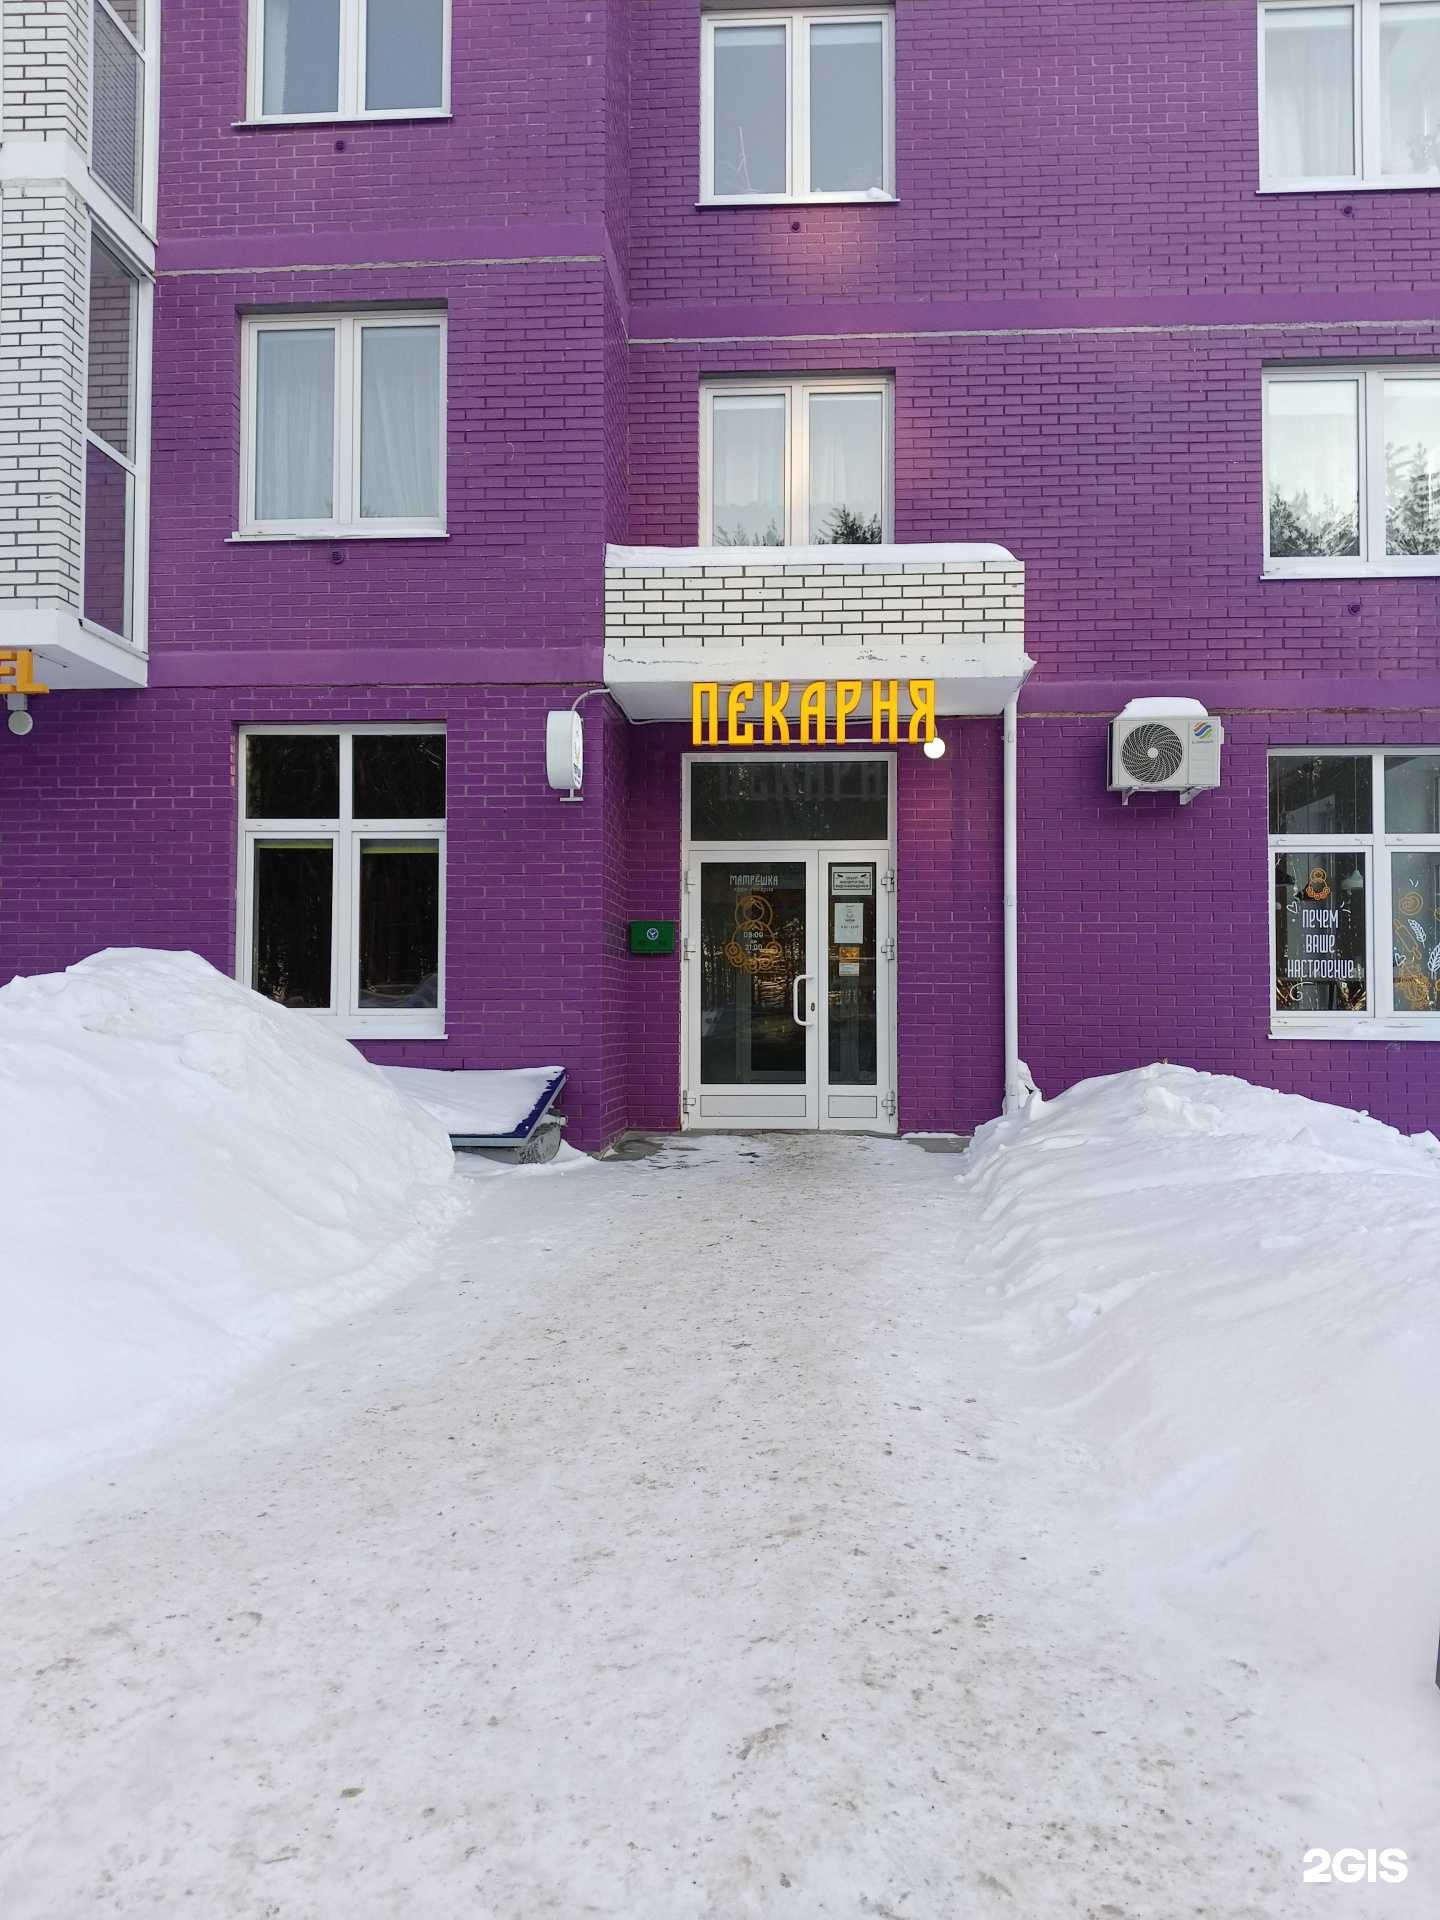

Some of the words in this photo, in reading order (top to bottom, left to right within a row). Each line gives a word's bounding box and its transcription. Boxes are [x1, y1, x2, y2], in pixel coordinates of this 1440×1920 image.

[692, 679, 935, 746] ПЕКАРНЯ
[1305, 934, 1336, 953] ВАШЕ
[1287, 959, 1354, 979] НАСТРОЕНИЕ
